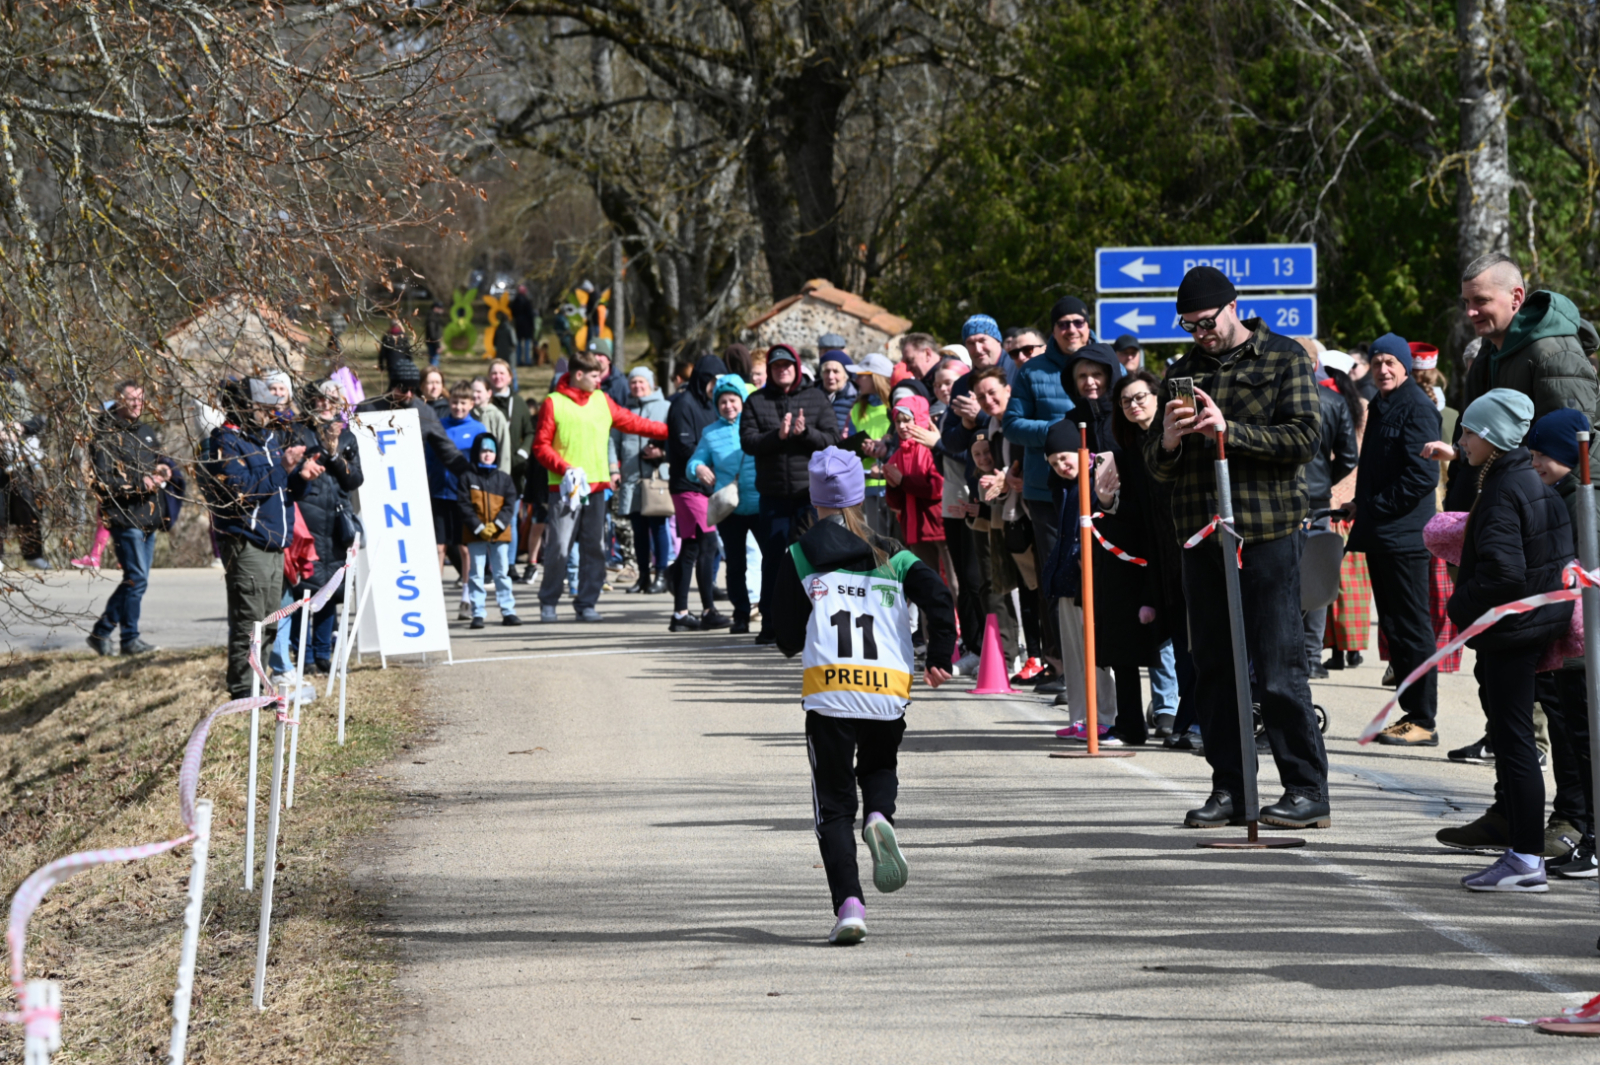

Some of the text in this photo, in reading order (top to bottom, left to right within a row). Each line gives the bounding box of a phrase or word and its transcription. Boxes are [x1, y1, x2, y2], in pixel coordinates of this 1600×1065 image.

[1273, 257, 1294, 276] 13
[1276, 308, 1300, 327] 26
[377, 429, 426, 638] FINIŠS
[837, 585, 866, 597] SEB
[830, 609, 879, 660] 11
[825, 668, 888, 691] PREIĻI
